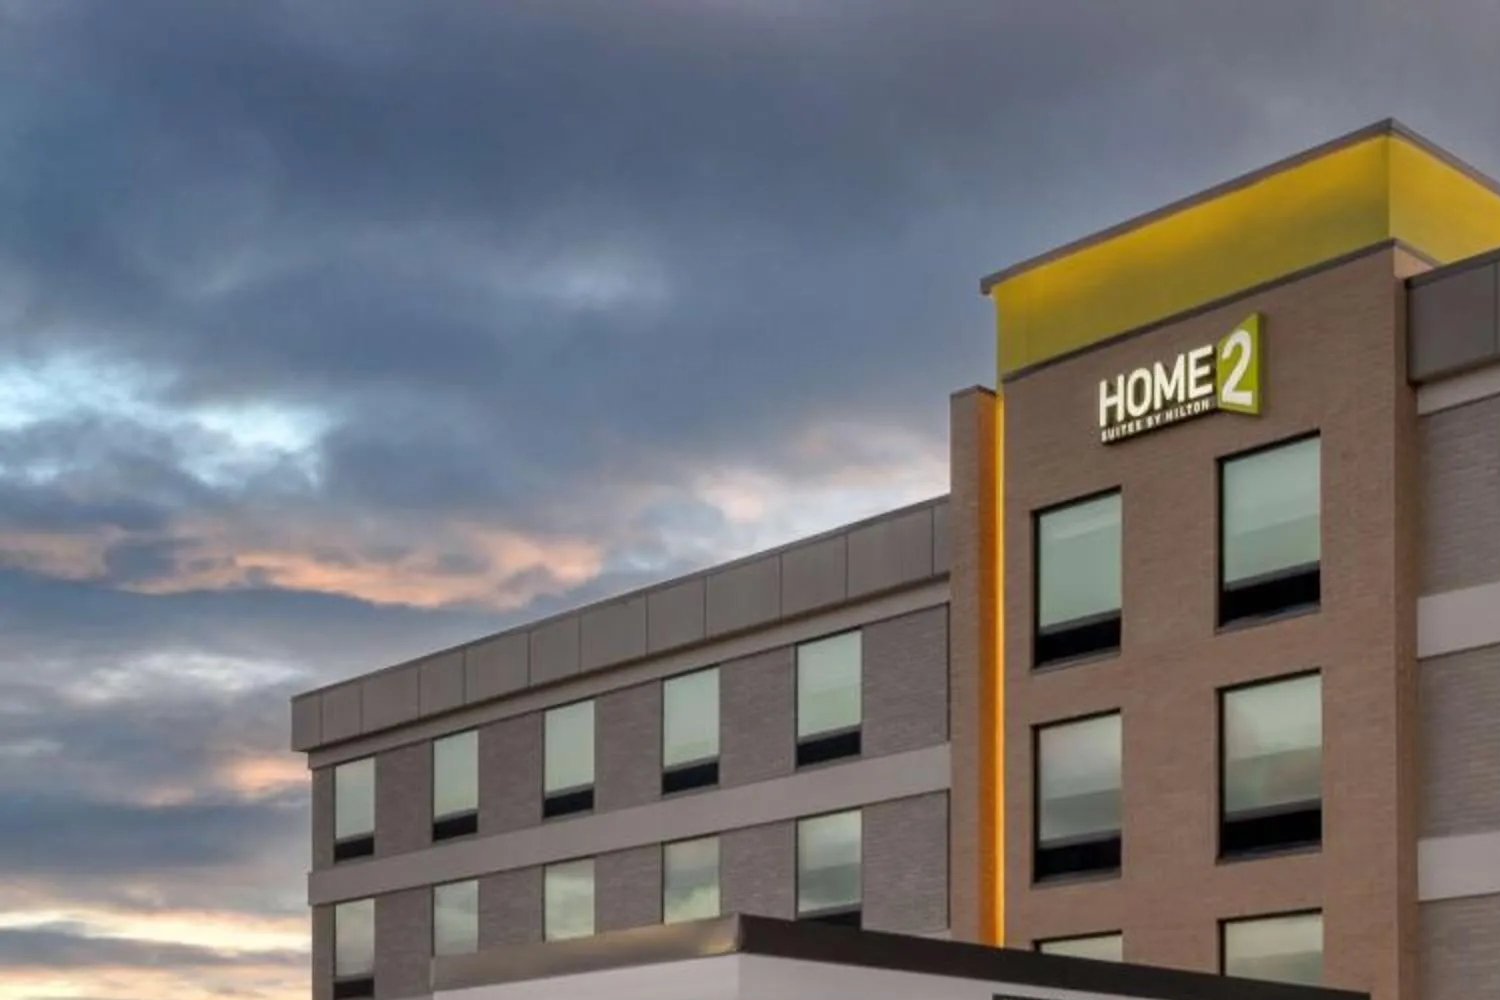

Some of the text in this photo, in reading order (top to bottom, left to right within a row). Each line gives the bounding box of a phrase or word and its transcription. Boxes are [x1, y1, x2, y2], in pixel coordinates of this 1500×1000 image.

[1101, 399, 1210, 442] SUITES BY HILTON
